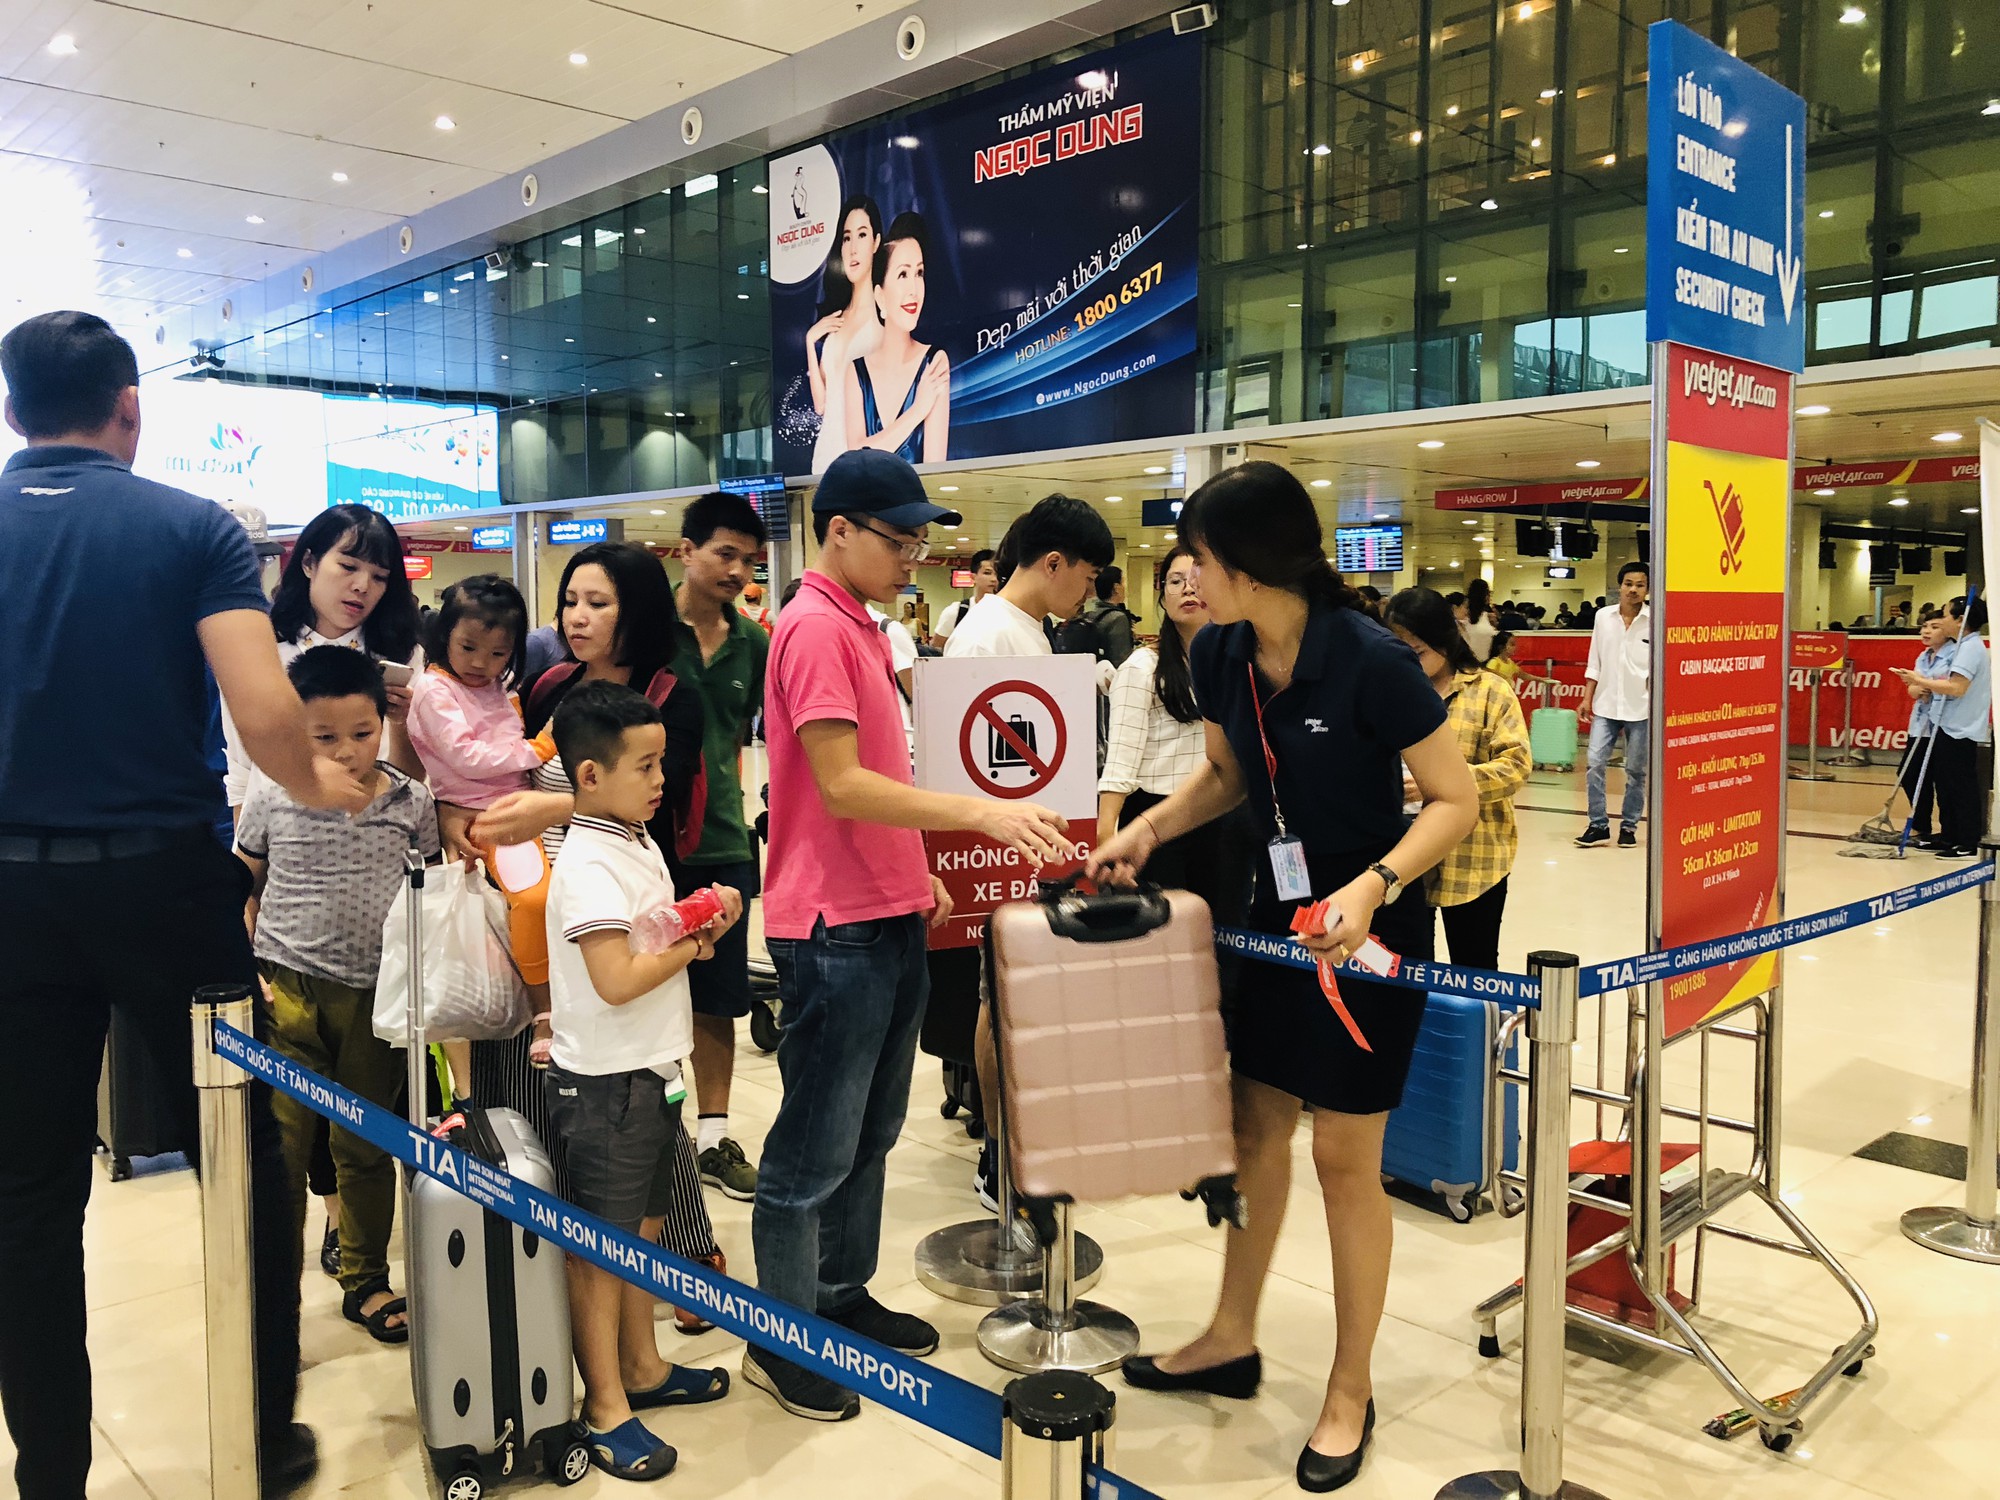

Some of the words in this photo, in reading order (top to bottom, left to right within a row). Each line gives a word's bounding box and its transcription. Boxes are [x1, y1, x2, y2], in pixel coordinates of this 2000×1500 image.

[998, 103, 1043, 133] THẨM
[1048, 92, 1073, 119] MỸ
[1075, 83, 1114, 109] VIỆN
[1678, 71, 1697, 119] LỐI
[1699, 83, 1722, 130] VÀO
[975, 130, 1050, 183] NGỌC
[1056, 103, 1143, 161] DUNG
[1677, 134, 1736, 193] ENTRANCE
[777, 230, 799, 246] NGỌC
[801, 222, 824, 238] DUNG
[1677, 198, 1707, 251] KIỂM
[1709, 219, 1730, 260] TRA
[1731, 229, 1748, 266] AN
[977, 322, 1011, 353] Đẹp
[1016, 297, 1040, 331] mãi
[1044, 277, 1068, 309] với
[1072, 250, 1103, 290] thời
[1109, 225, 1142, 271] gian
[1675, 266, 1730, 316] SECURITY
[1731, 285, 1765, 327] CHECK
[1015, 326, 1073, 364] HOTLINE:
[1075, 293, 1117, 333] 1800
[1120, 262, 1163, 305] 6377
[1045, 353, 1156, 403] www.NgocDung.com
[1511, 489, 1518, 504] J
[1666, 626, 1696, 644] KHUNG
[1697, 626, 1710, 643] ĐO
[1711, 620, 1734, 642] HÀNH
[1734, 620, 1744, 641] LÝ
[1744, 620, 1764, 640] XÁCH
[1764, 624, 1779, 639] TAY
[1680, 659, 1701, 675] CABIN
[1702, 657, 1734, 674] BAGGAGE
[1734, 656, 1749, 671] TEST
[1749, 655, 1766, 670] UNIT
[1721, 703, 1732, 720] 01
[1677, 766, 1682, 780] 1
[1682, 761, 1698, 780] KIỆN
[1701, 754, 1717, 774] KHỐI
[1680, 820, 1697, 846] GIỚI
[1697, 821, 1715, 842] HẠN
[1723, 809, 1762, 834] LIMITATION
[937, 844, 1020, 871] KHÔNG
[1683, 856, 1704, 875] 56cm
[1705, 850, 1712, 868] X
[1712, 848, 1733, 866] 36cm
[1733, 843, 1739, 860] X
[1740, 840, 1759, 858] 23cm
[973, 881, 1003, 902] XE
[1010, 867, 1039, 899] ĐẨ
[1920, 884, 1933, 899] TAN
[1933, 881, 1946, 895] SON
[1946, 875, 1962, 890] NHAT
[1868, 895, 1894, 918] TIA
[1213, 927, 1246, 949] ẢNG
[1248, 935, 1287, 958] HÀNG
[1675, 949, 1700, 968] CẢNG
[1701, 943, 1726, 962] HÀNG
[1728, 936, 1758, 956] KHÔNG
[1759, 927, 1782, 947] QUỐC
[1783, 922, 1794, 941] TẾ
[1795, 921, 1810, 938] TÂN
[1811, 918, 1828, 933] SƠN
[1828, 908, 1849, 928] NHẤT
[1431, 968, 1467, 989] TÂN
[1472, 975, 1514, 997] SƠN
[1596, 962, 1635, 989] TIA
[1669, 970, 1707, 1001] 19001886
[246, 1048, 273, 1075] QUỐC
[275, 1060, 286, 1084] TẾ
[288, 1069, 309, 1096] TÂN
[310, 1082, 334, 1110] SƠN
[335, 1093, 364, 1126] NHẤT
[408, 1129, 460, 1186] TIA
[468, 1158, 481, 1174] TAN
[481, 1165, 494, 1180] SON
[494, 1172, 512, 1189] NHAT
[467, 1171, 516, 1205] INTERNATIONAL
[468, 1185, 495, 1206] AIRPORT
[528, 1197, 557, 1231] TAN
[561, 1215, 597, 1251] SON
[601, 1234, 647, 1275] NHAT
[651, 1258, 816, 1356] INTERNATIONAL
[821, 1337, 933, 1407] AIRPORT
